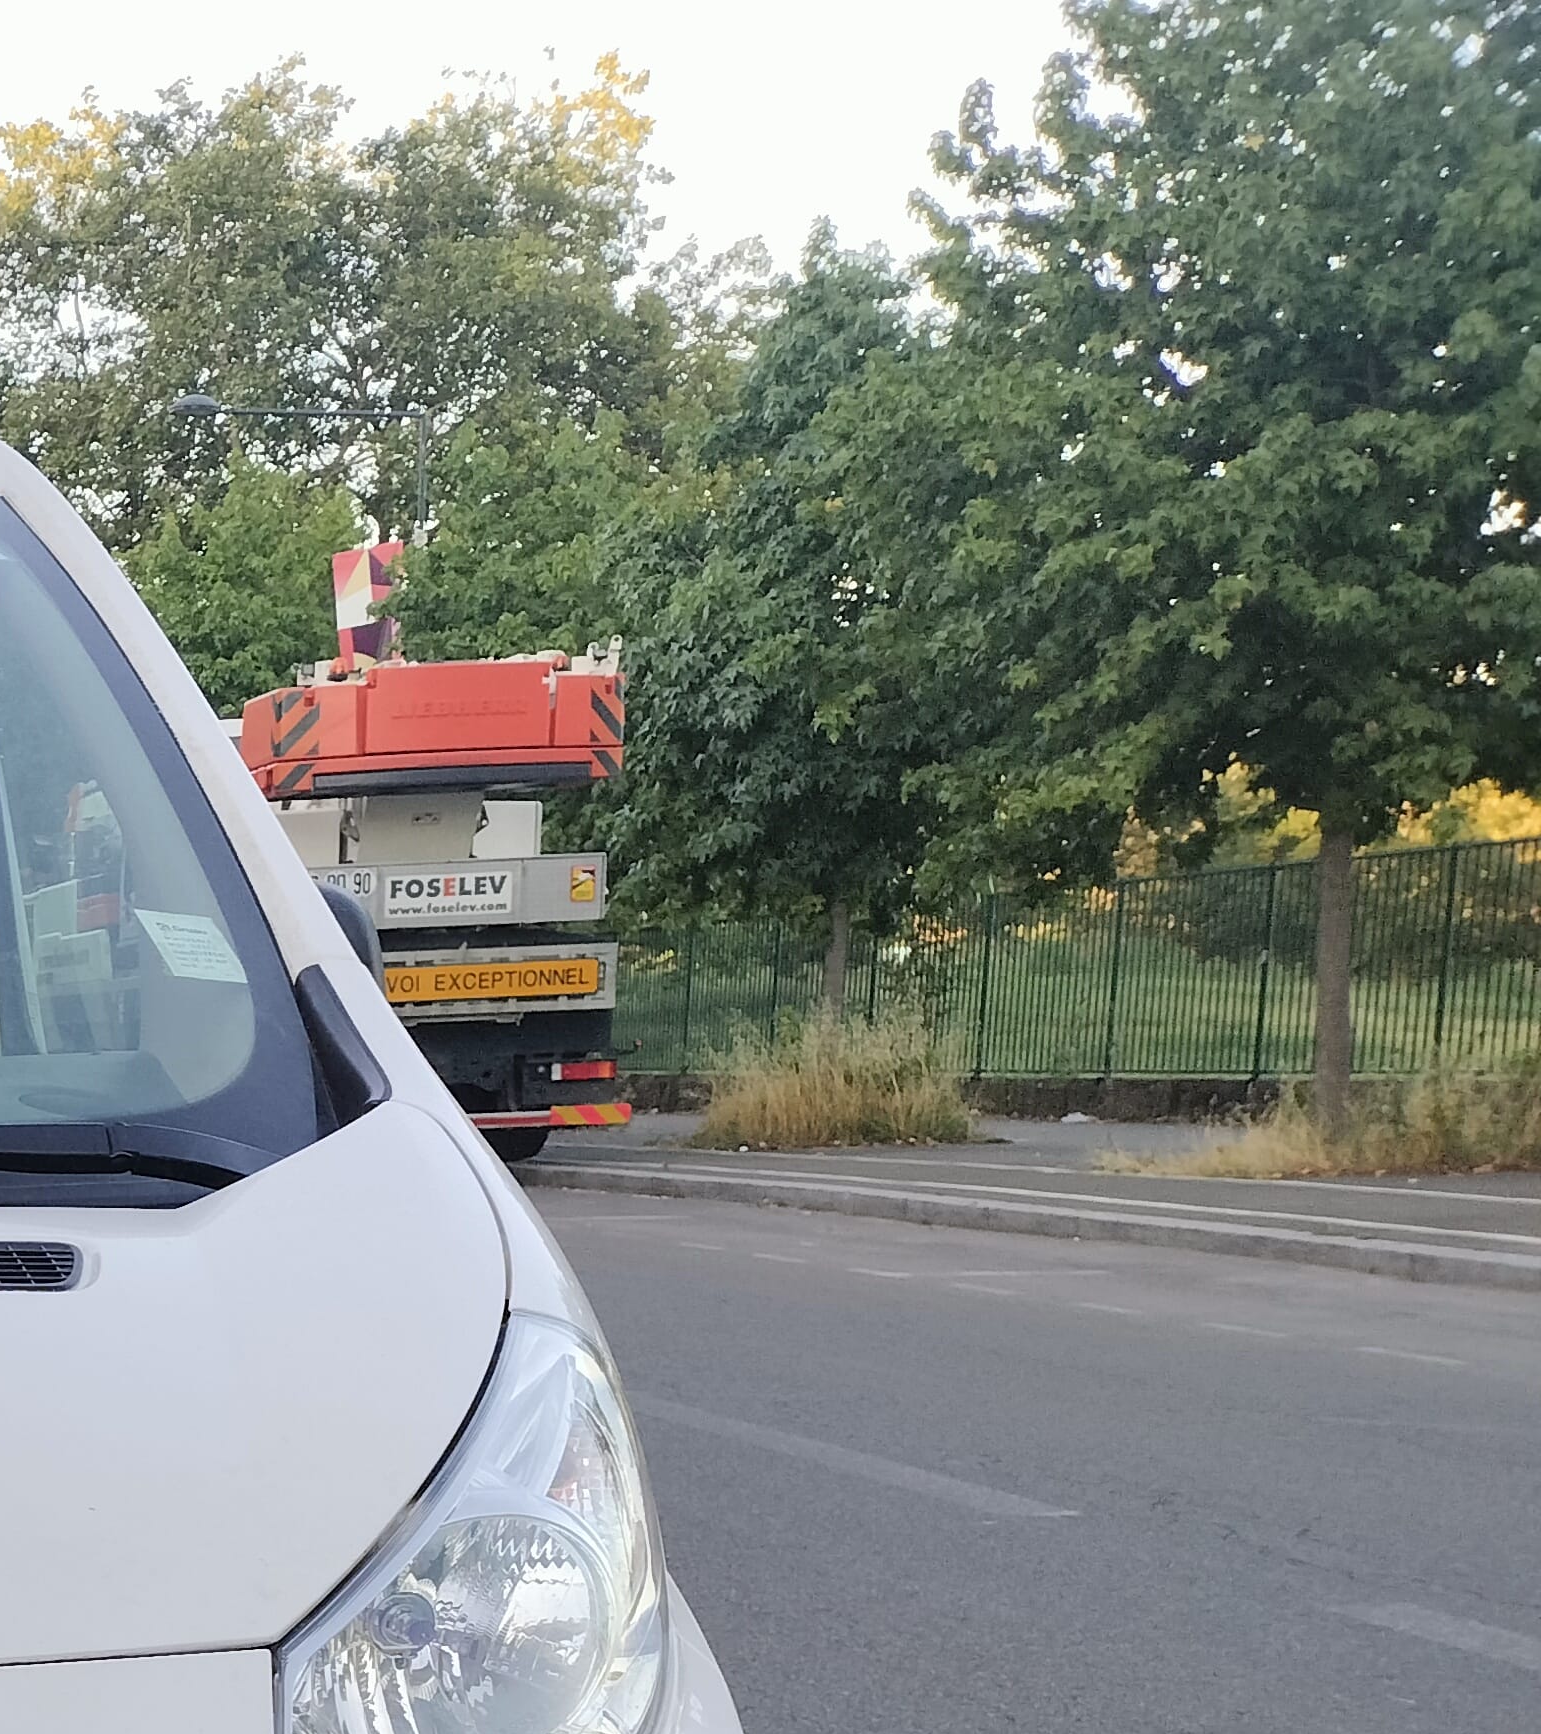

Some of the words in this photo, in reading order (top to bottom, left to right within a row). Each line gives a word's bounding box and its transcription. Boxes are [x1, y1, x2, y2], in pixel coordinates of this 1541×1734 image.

[353, 872, 371, 895] 90
[390, 875, 507, 899] FOSELEV
[388, 902, 507, 915] www.foselev.com
[434, 968, 589, 991] EXCEPTIONNEL
